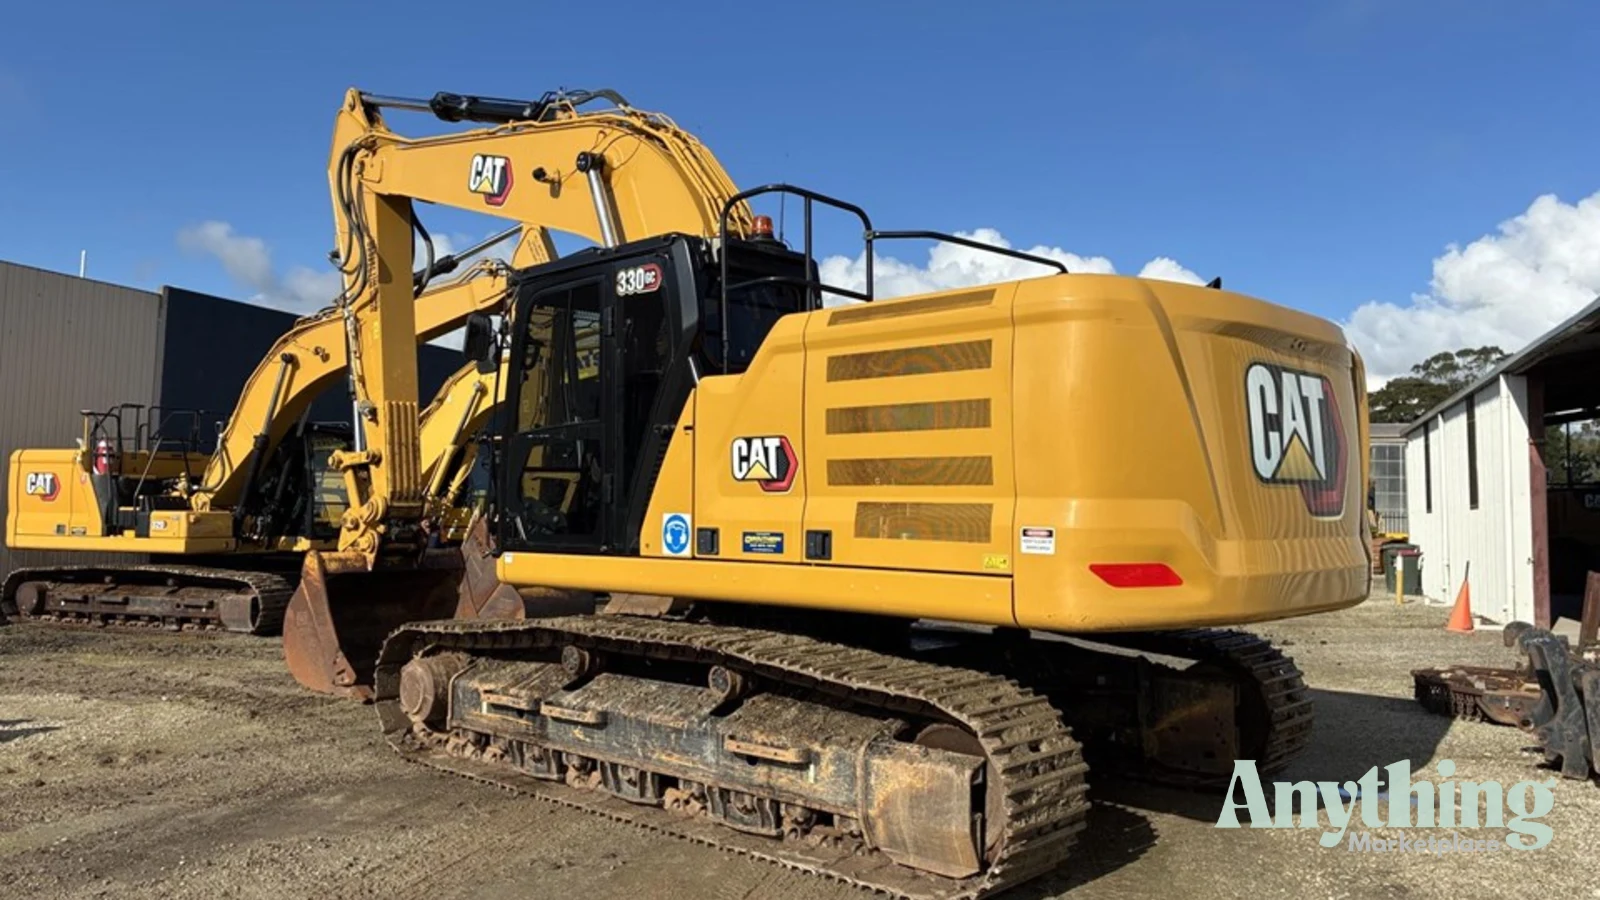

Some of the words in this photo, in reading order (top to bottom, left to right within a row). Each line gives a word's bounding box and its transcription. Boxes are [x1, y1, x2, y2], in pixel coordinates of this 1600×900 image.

[469, 154, 506, 194] CAT
[616, 267, 644, 293] 330
[1247, 364, 1326, 480] CAT
[732, 437, 780, 480] CAT
[27, 472, 54, 495] CAT
